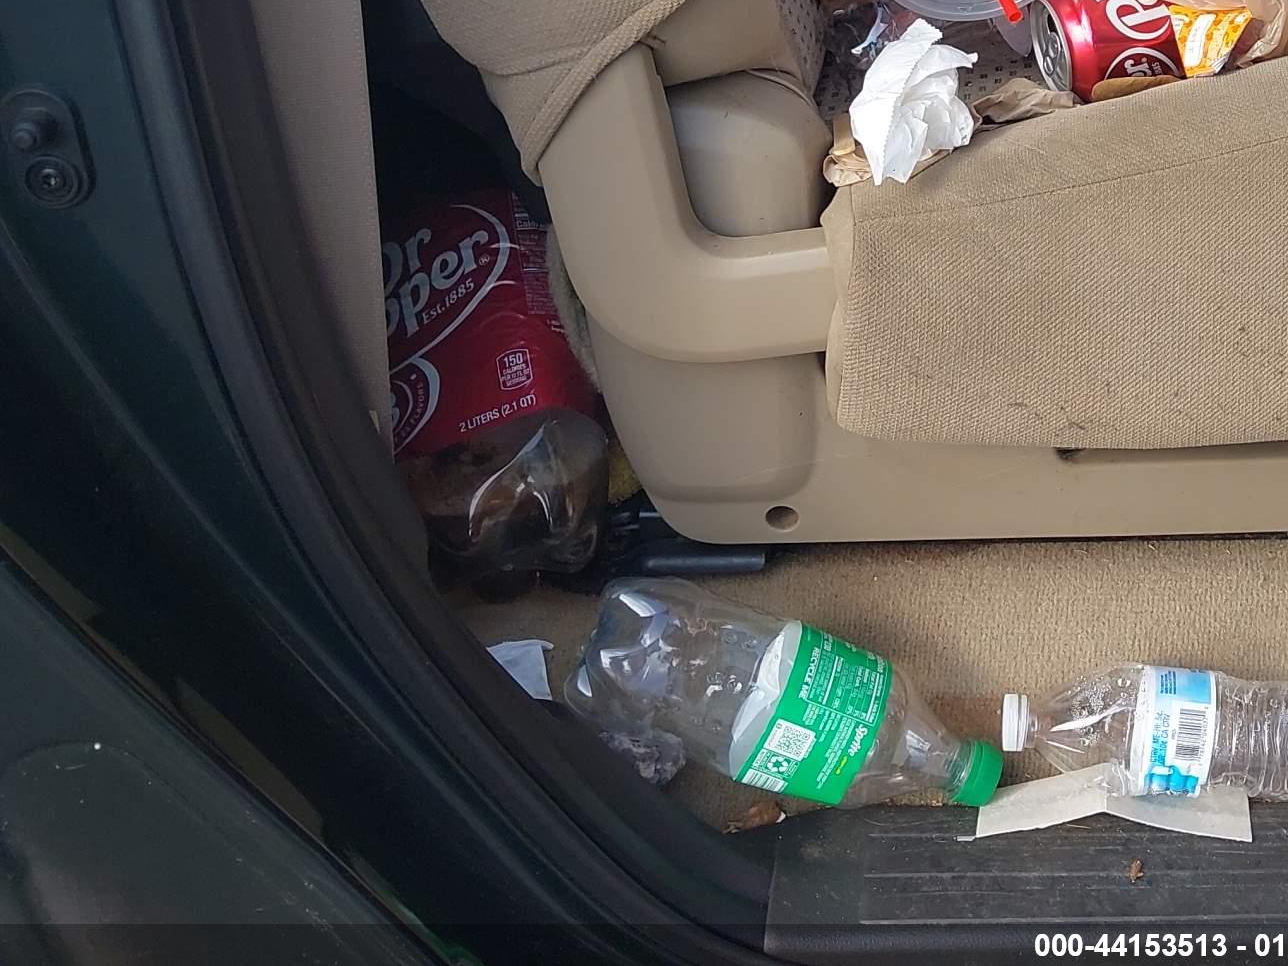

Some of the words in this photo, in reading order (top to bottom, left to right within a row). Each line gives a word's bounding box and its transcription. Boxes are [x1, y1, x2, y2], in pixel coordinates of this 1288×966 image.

[503, 352, 524, 367] 150
[460, 421, 468, 432] 2
[468, 408, 500, 430] LITERS
[804, 647, 821, 688] RECYCLE
[798, 686, 810, 699] ME
[848, 723, 868, 757] Sprite
